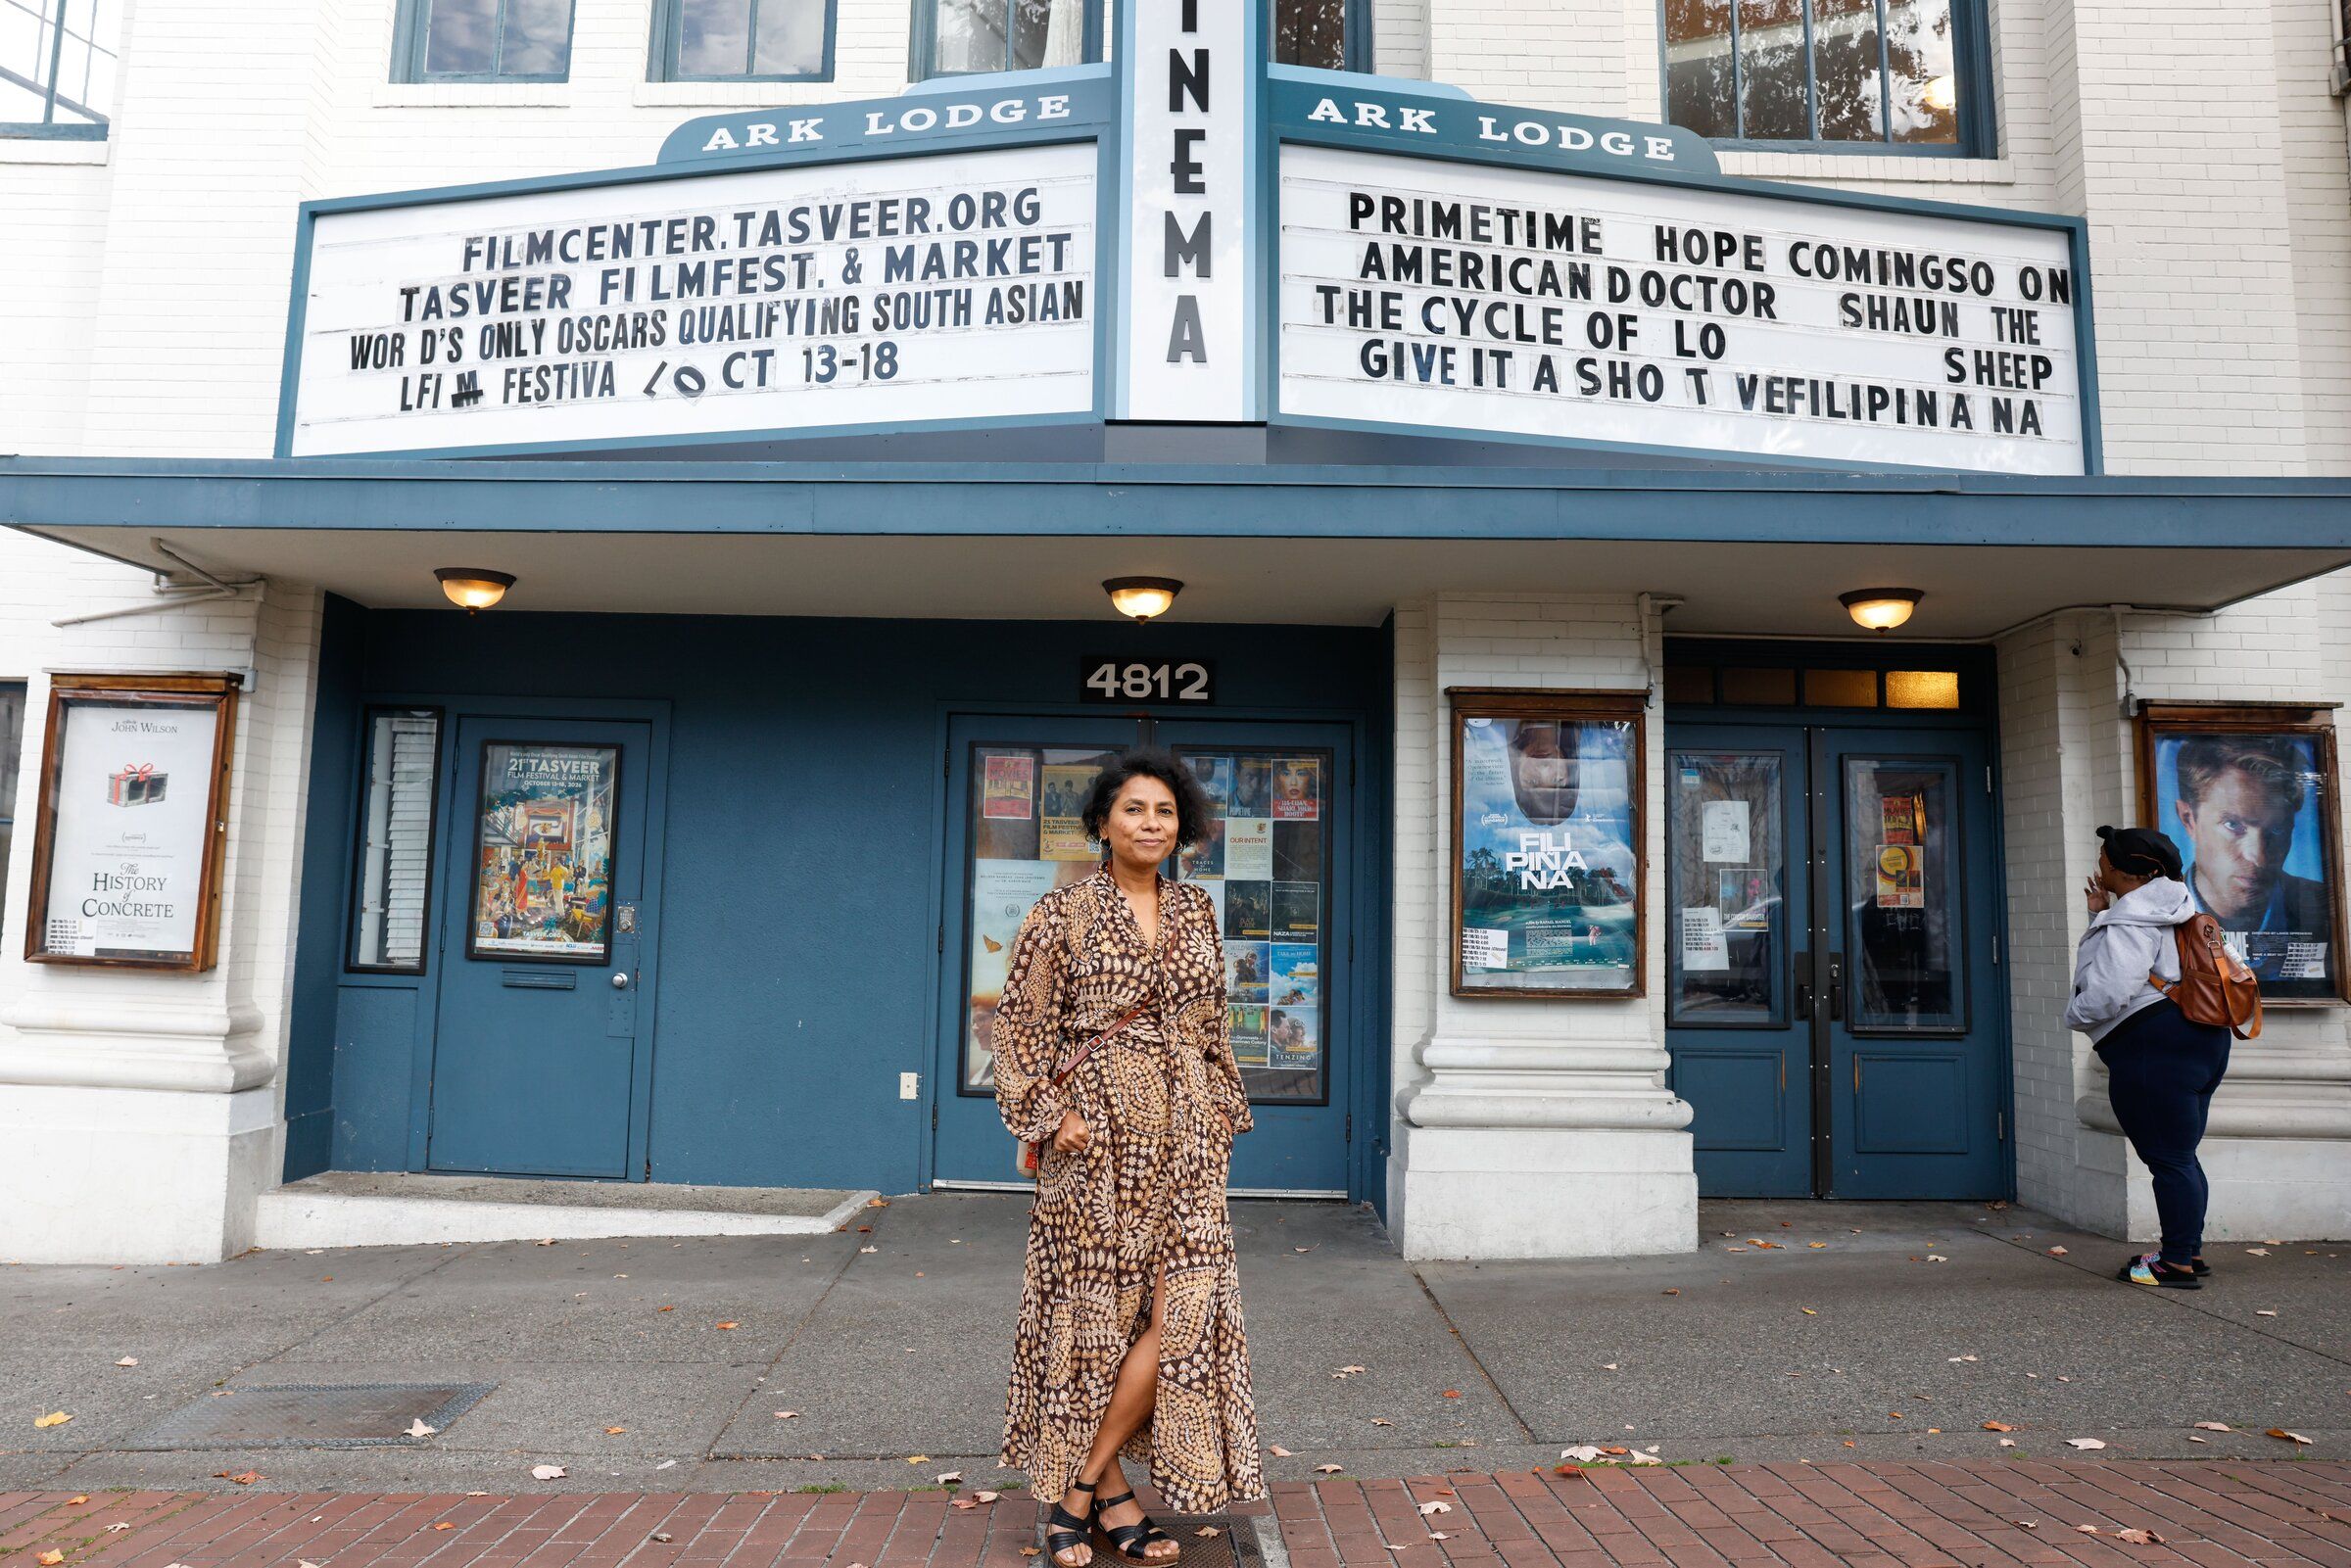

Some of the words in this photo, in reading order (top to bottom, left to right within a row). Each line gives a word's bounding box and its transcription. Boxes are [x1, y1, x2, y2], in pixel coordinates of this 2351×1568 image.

[702, 118, 824, 152] ARK
[865, 94, 1071, 136] LODGE
[1308, 98, 1437, 134] ARK
[1478, 116, 1675, 162] LODGE
[462, 187, 1040, 272] FILMCENTER.TASVEER.ORG
[1350, 192, 1603, 255] PRIMETIME
[1655, 225, 1764, 271] HOPE
[401, 274, 572, 322] TASVEER
[842, 249, 861, 284] &
[885, 233, 1071, 283] MARKET
[1360, 242, 1592, 301] AMERICAN
[1607, 265, 1777, 319] DOCTOR
[1841, 293, 1958, 337] SHAUN
[1991, 307, 2039, 345] THE
[480, 318, 545, 359] ONLY
[558, 309, 666, 354] OSCARS
[679, 296, 859, 344] QUALIFYING
[873, 289, 971, 331] SOUTH
[985, 281, 1082, 324] ASIAN
[1317, 285, 1402, 330] THE
[1421, 297, 1562, 345] CYCLE
[1587, 311, 1637, 351] OF
[1944, 348, 2052, 390] SHEEP
[504, 361, 614, 404] FESTIVA
[803, 342, 897, 383] 13-18
[1361, 339, 1456, 385] GIVE
[1473, 348, 1512, 388] IT
[1533, 355, 1559, 393] A
[1086, 663, 1209, 700] 4812
[112, 721, 138, 734] JOHN
[140, 722, 177, 734] WILSON
[526, 772, 560, 781] FESTIVAL
[529, 759, 600, 775] TASVEER
[120, 862, 139, 876] The
[1519, 832, 1571, 852] FILI
[93, 873, 168, 891] HISTORY
[1521, 870, 1574, 890] NA
[82, 898, 174, 918] CONCRETE
